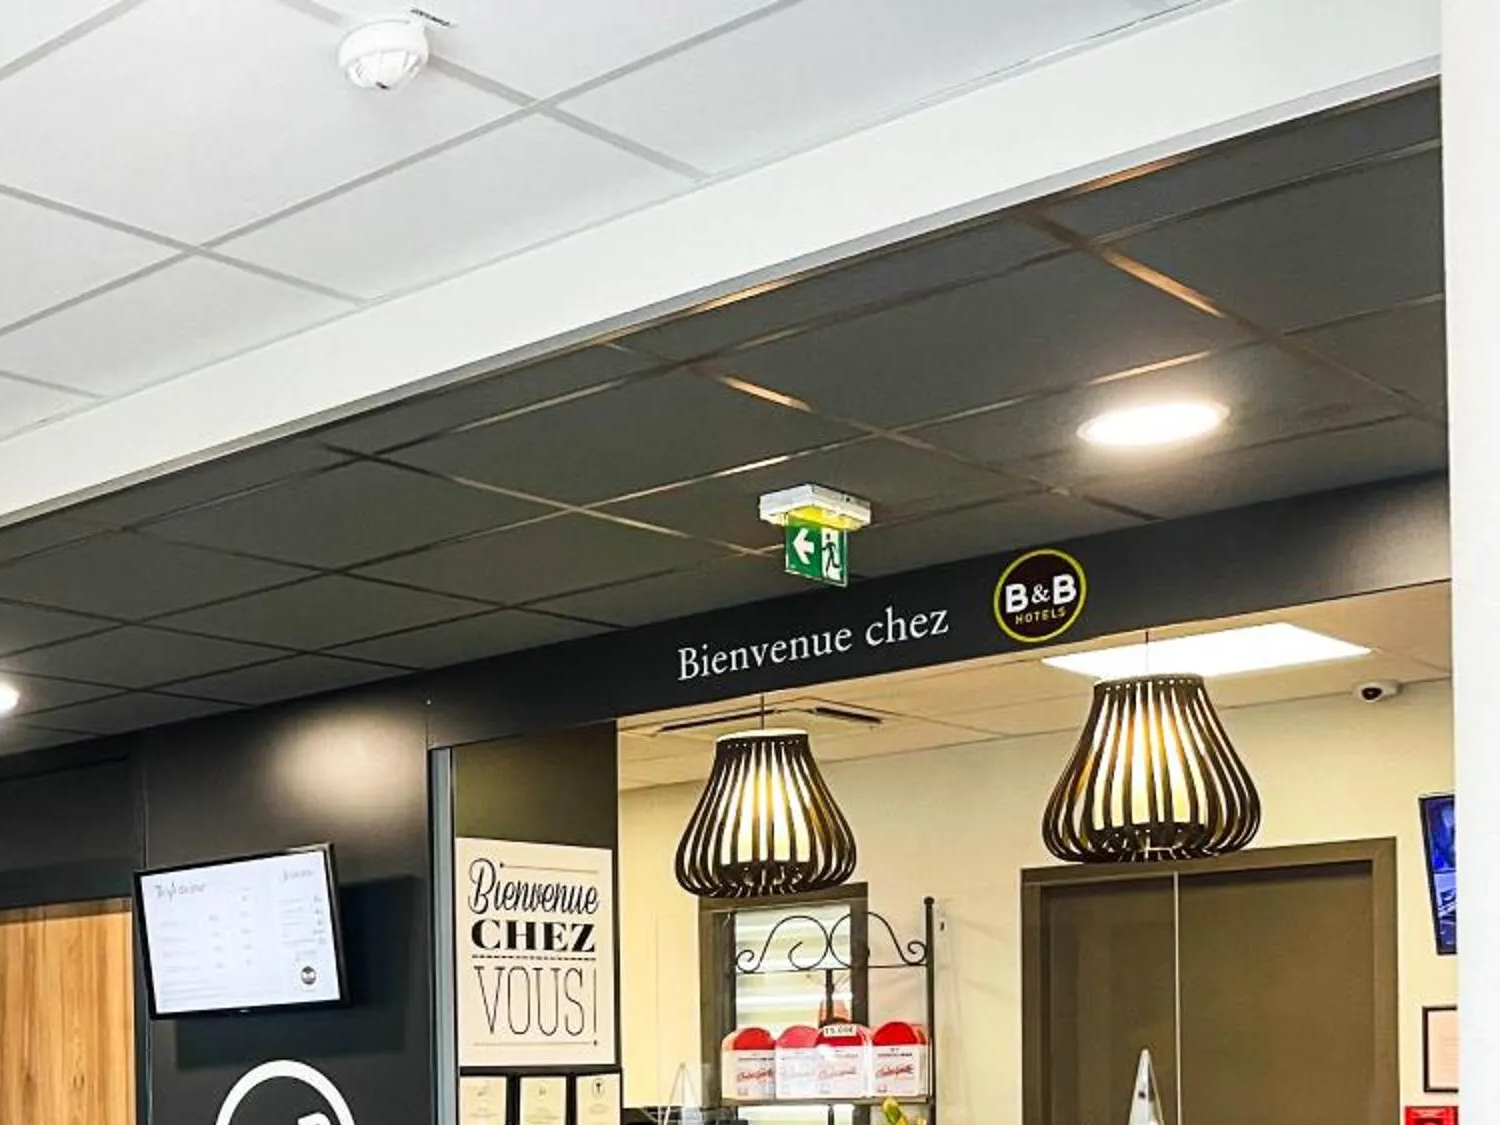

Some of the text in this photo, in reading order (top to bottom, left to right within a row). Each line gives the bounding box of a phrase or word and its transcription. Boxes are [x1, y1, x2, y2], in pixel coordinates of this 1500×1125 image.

[1005, 573, 1077, 613] B&B
[1015, 606, 1066, 625] HOTELS
[677, 606, 949, 681] Bienvenue chez
[468, 858, 599, 914] Bienvenue
[471, 919, 595, 952] CHEZ
[473, 965, 598, 1046] VOUS!
